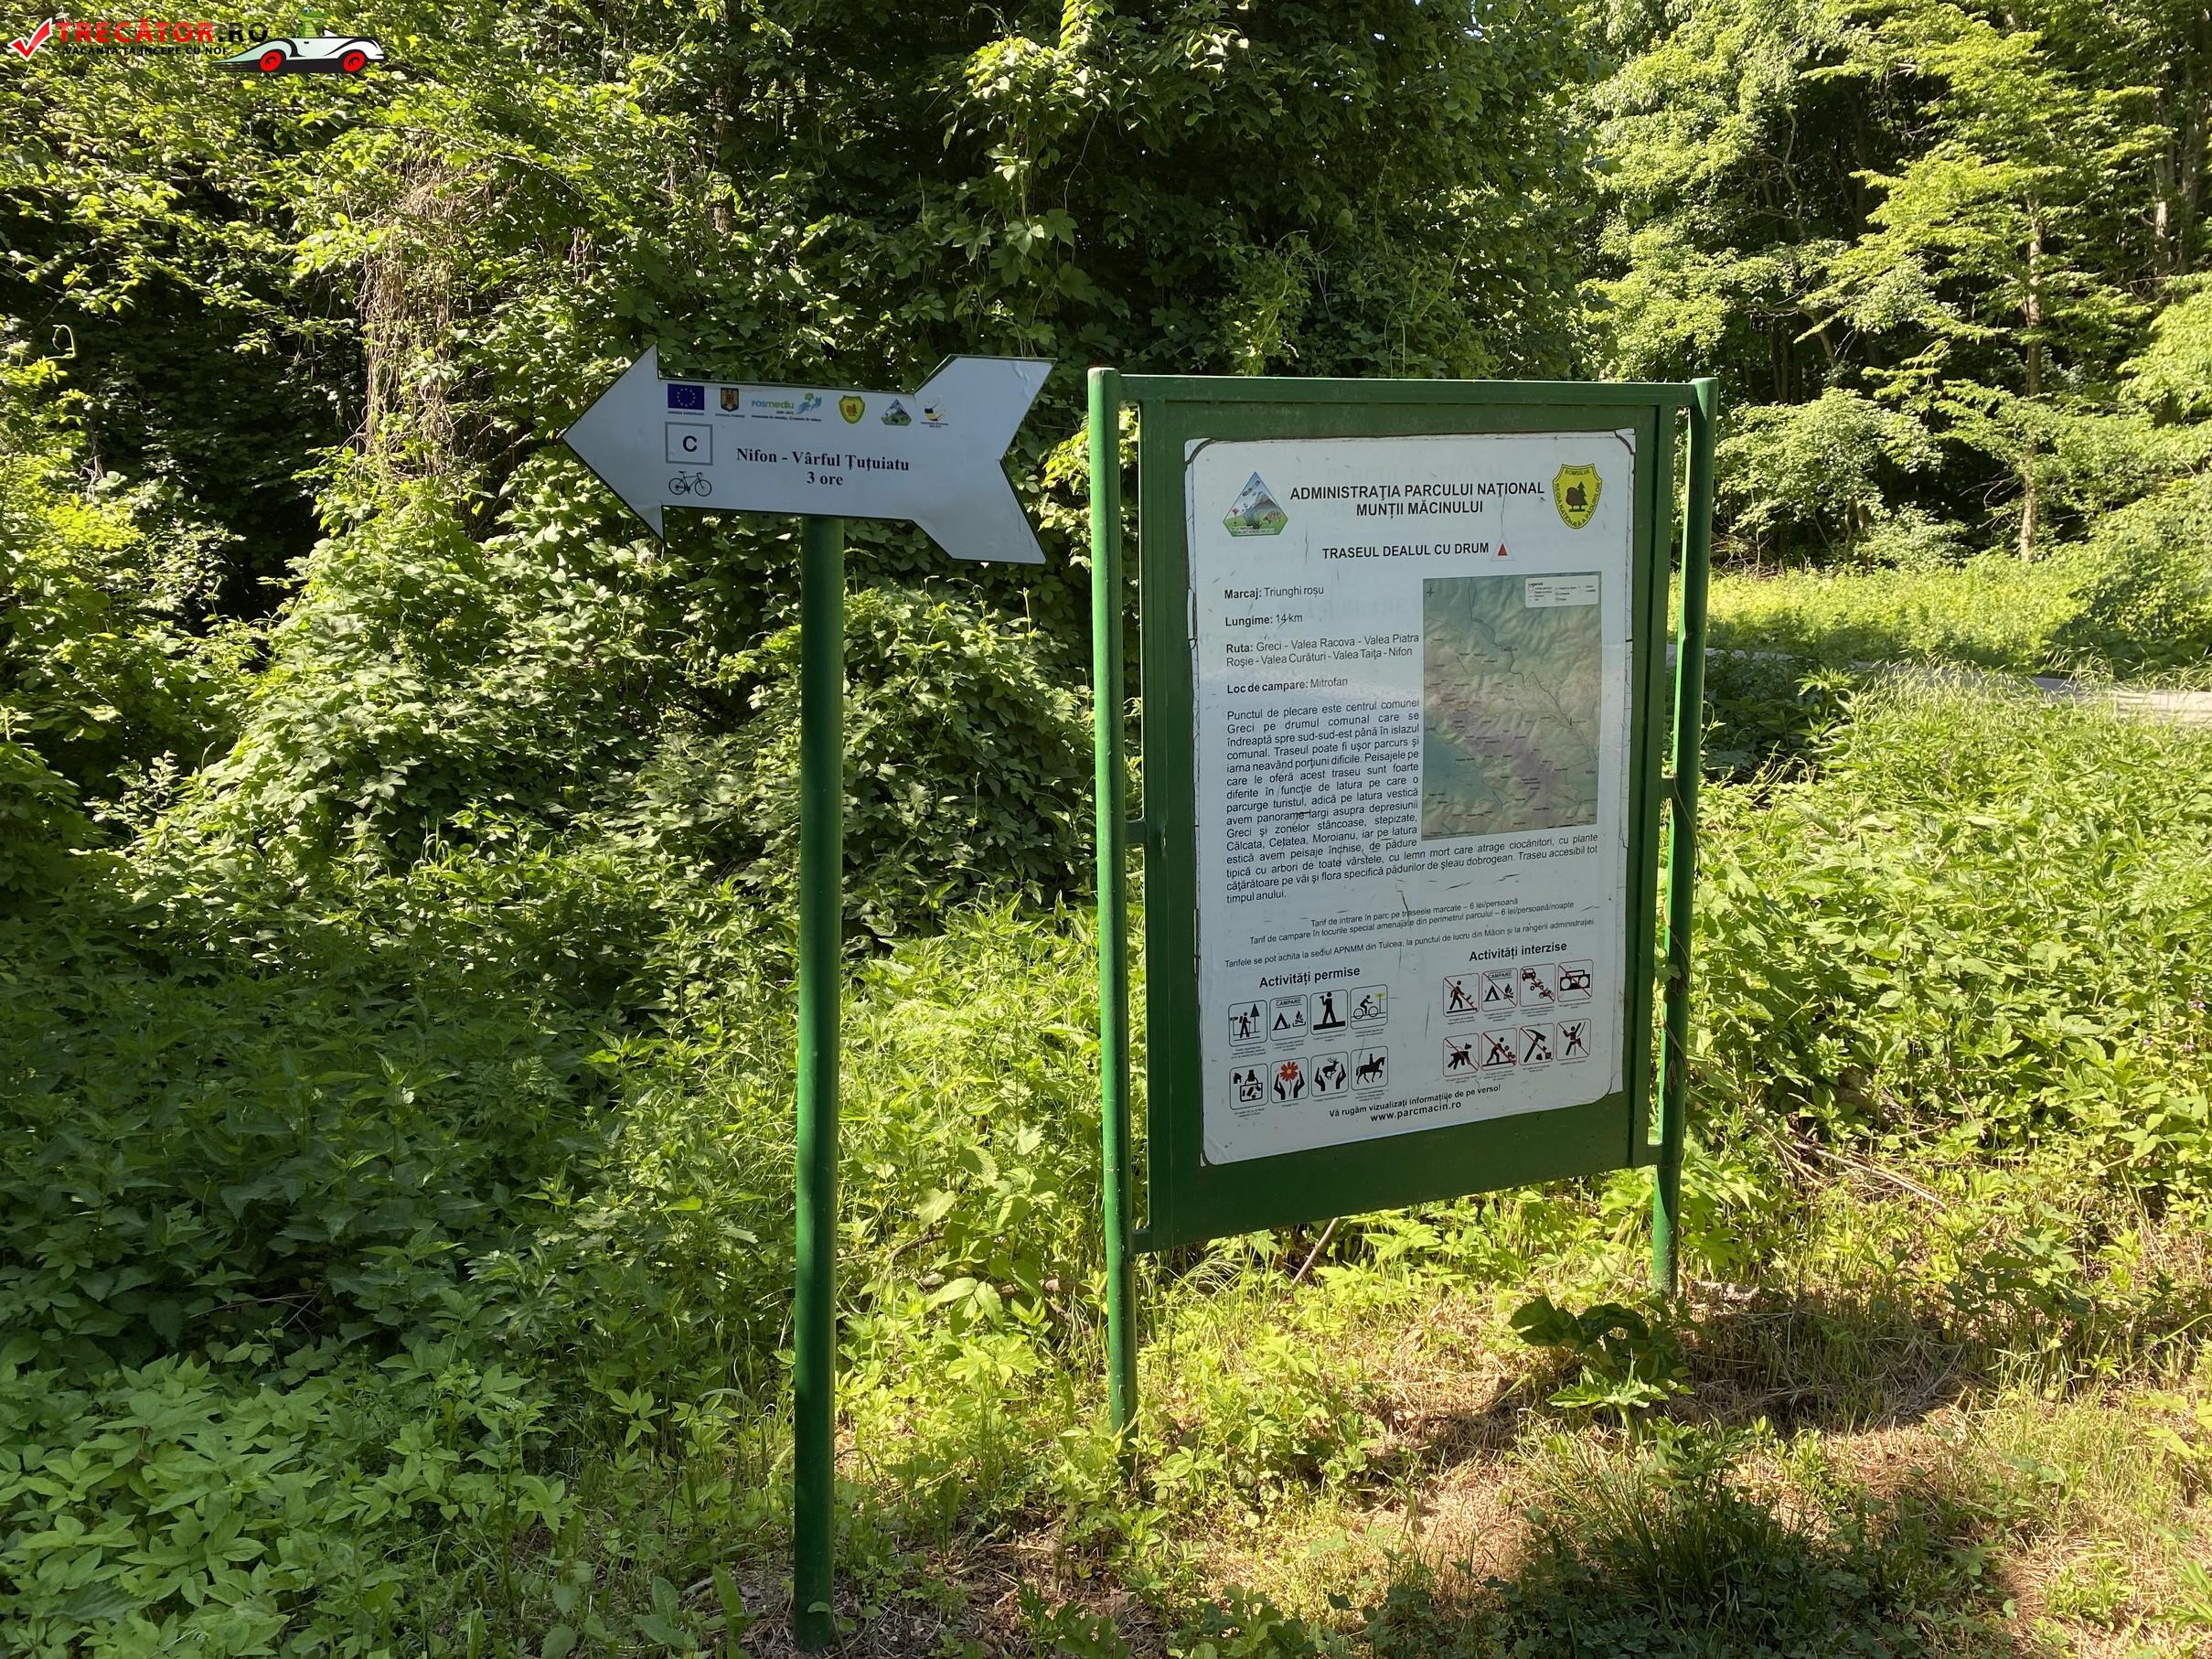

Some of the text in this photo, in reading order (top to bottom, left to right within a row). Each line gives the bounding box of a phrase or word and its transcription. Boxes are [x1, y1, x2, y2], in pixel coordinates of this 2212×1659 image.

[682, 435, 697, 453] C
[736, 447, 777, 463] Nifon
[792, 451, 840, 467] Vârful
[807, 471, 843, 486] 3 ore
[1405, 483, 1473, 498] PARCULUI
[1407, 500, 1483, 515] MĂCINULUI
[1321, 541, 1489, 560] TRASEUL DEALUL CU DRUM
[1224, 587, 1262, 599] Marcaj:
[1264, 585, 1302, 598] Triunghi
[1224, 613, 1303, 627] Lungime: km
[1225, 634, 1419, 654] Ruta: Greci Valea Racova Valea Piatra
[1260, 647, 1413, 665] Valea Curături Valea Nifon
[1226, 677, 1348, 694] Loc de campare: Mitrofan
[1226, 700, 1420, 721] Punctul de plecare este centrul comunei
[1226, 712, 1419, 734] Greci pe drumul comunal care se
[1227, 722, 1419, 747] îndreaptă spre sud-sud-est până în islazul
[1226, 738, 1408, 761] comunal. Traseul poate fi parcurs
[1226, 750, 1419, 774] iarna neavând dificile. Peisajele pe
[1226, 762, 1419, 787] care le oferă acest traseu sunt foarte
[1226, 776, 1419, 800] diferite în de latura pe care o
[1226, 787, 1418, 815] parcurge turistul, adică latura vestică
[1226, 816, 1253, 826] avem
[1332, 806, 1365, 817] asupra
[1369, 801, 1418, 814] depresiunii
[1226, 813, 1417, 839] Greci zonelor stâncoase, stepizate,
[1226, 826, 1417, 851] Călcata, Moroianu, latura
[1226, 838, 1417, 865] estică avem peisaje închise, pădure
[1226, 833, 1598, 880] tipică arbori toate vârstele, lemn mort care atrage ciocănitori, plante
[1295, 845, 1586, 883] văi flora specifică pădurilor dobrogean. Traseu accesibil
[1226, 889, 1287, 904] timpul anului.
[1521, 942, 1567, 956] interzise
[1314, 967, 1361, 984] permise
[1329, 1108, 1340, 1118] Vă
[1341, 1106, 1367, 1116] rugăm
[1454, 1089, 1464, 1098] de
[1465, 1089, 1476, 1097] pe
[1477, 1084, 1501, 1095] verso!
[1370, 1101, 1462, 1122] www.parcmacin.ro
